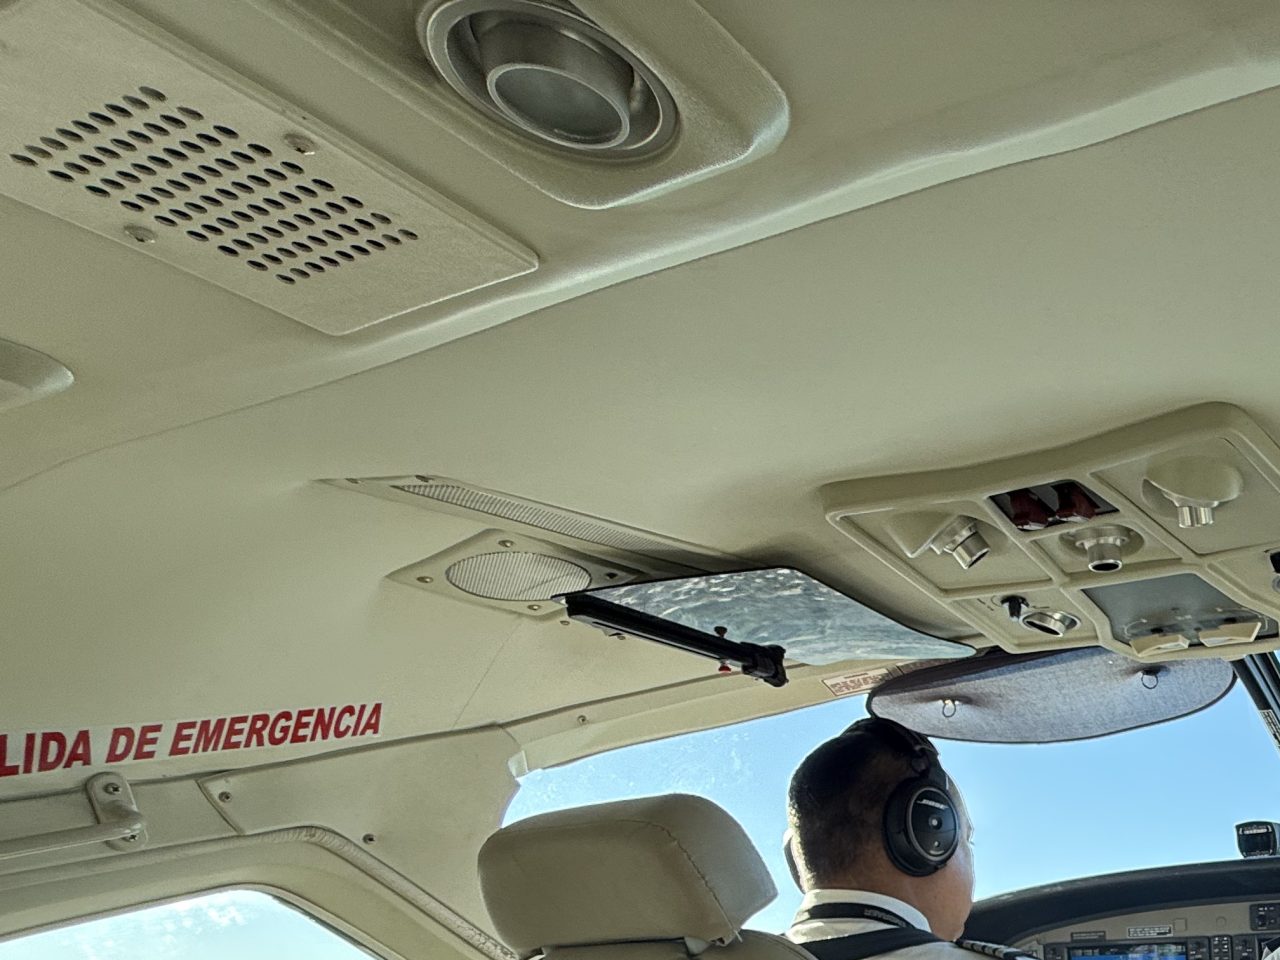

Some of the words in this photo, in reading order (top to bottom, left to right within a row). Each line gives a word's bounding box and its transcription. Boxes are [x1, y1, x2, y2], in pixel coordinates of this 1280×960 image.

[0, 729, 91, 777] LIDA
[105, 724, 163, 763] DE
[169, 703, 382, 756] EMERGENCIA
